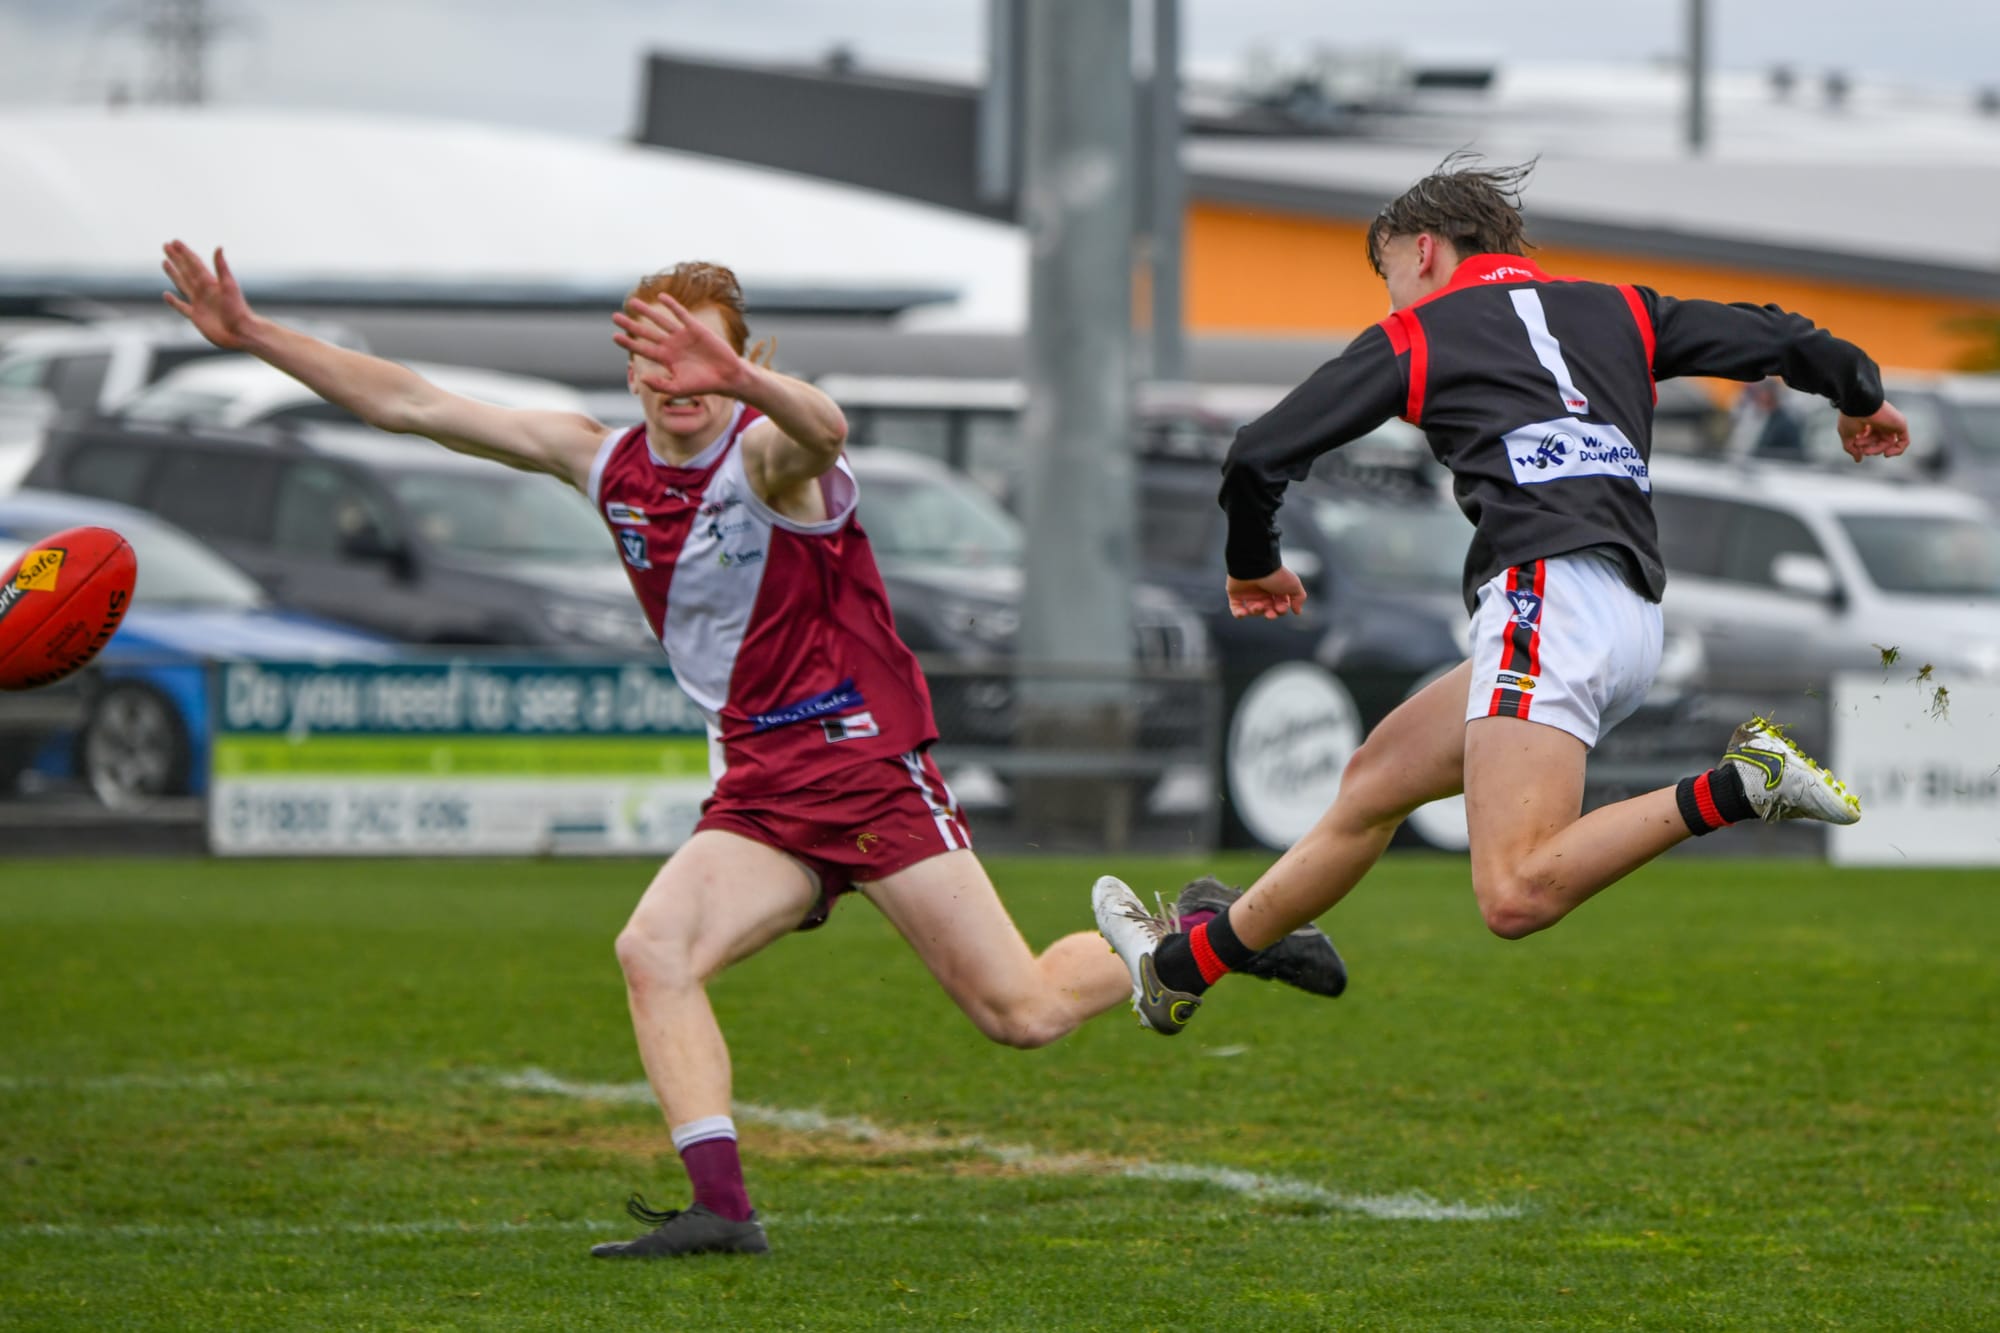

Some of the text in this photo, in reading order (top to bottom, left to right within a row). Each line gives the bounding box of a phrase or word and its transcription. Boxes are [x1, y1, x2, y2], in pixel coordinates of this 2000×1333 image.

[1508, 288, 1589, 415] 1
[18, 552, 58, 586] Safe
[228, 665, 284, 728] Do
[288, 672, 358, 744] you
[372, 661, 464, 729] need
[466, 668, 509, 729] to
[518, 676, 581, 729] see
[586, 676, 617, 729] a
